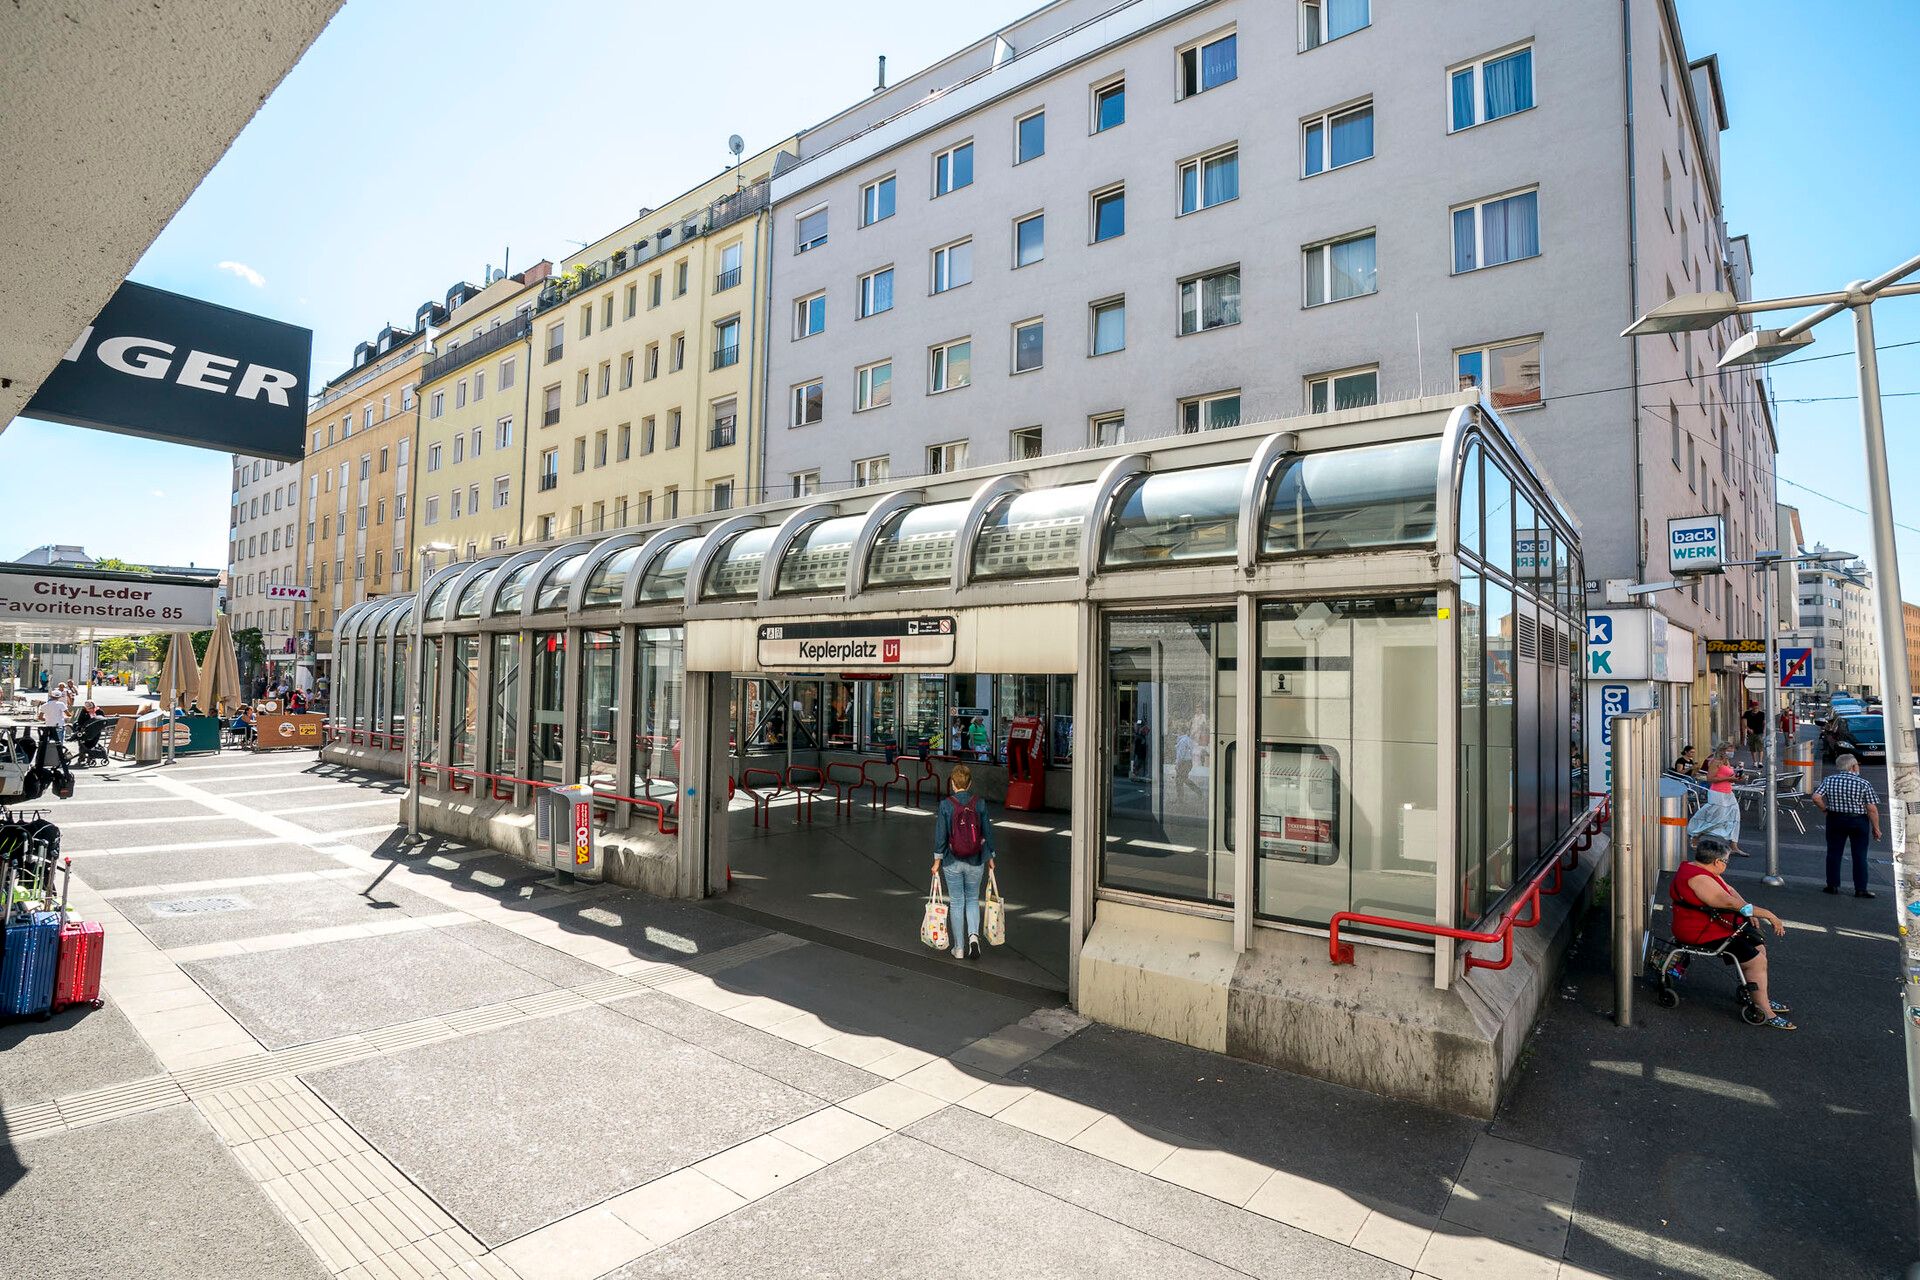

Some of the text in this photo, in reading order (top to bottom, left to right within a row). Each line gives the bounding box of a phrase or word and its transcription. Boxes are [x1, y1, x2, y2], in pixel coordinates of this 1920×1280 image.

[1674, 528, 1713, 543] back
[1673, 545, 1717, 560] WERK
[34, 581, 152, 601] City-Leder
[271, 587, 307, 598] SEWA
[162, 606, 183, 620] 85
[799, 641, 899, 662] Keplerplatz U1
